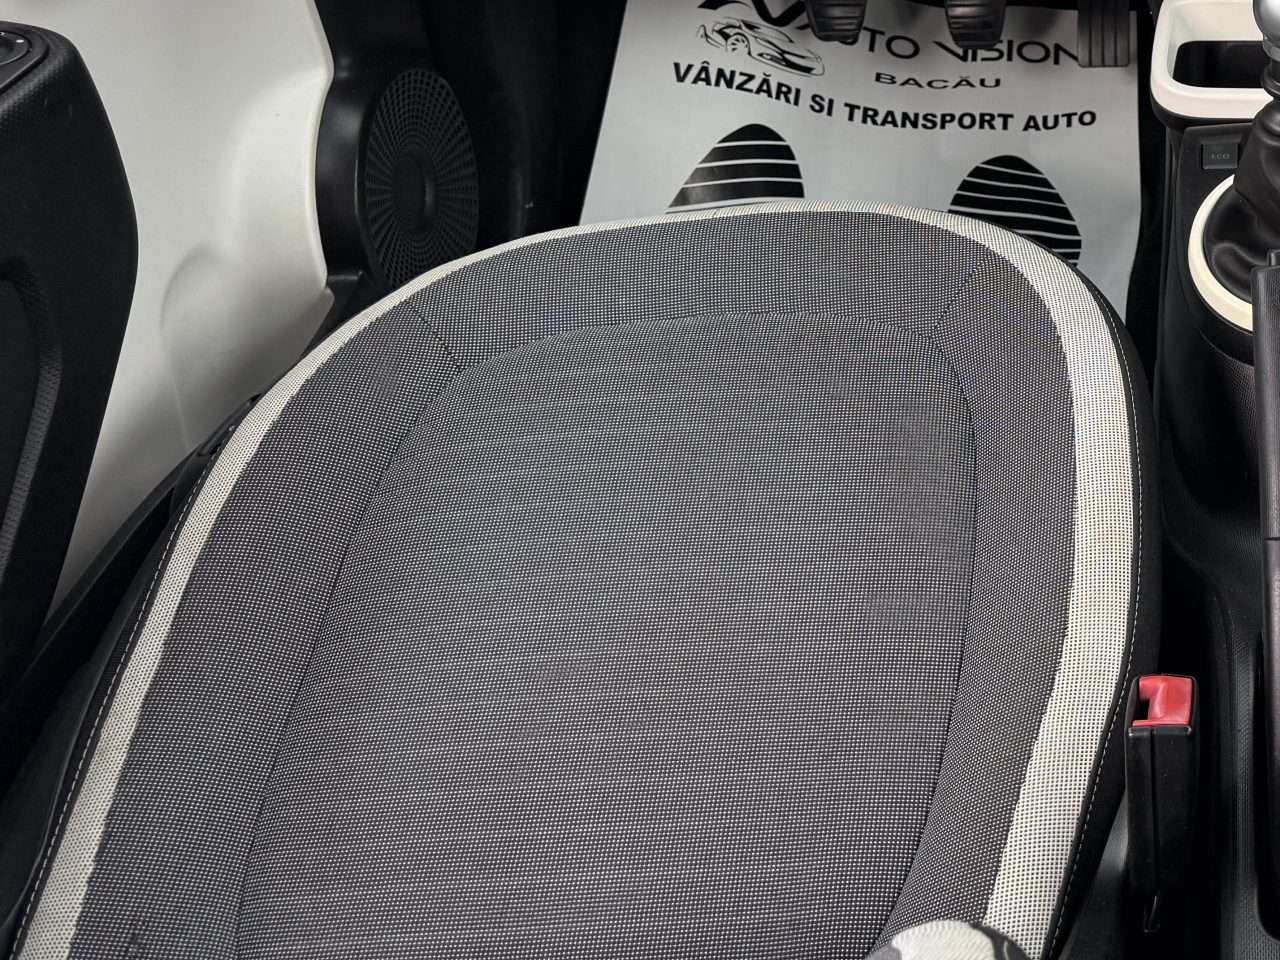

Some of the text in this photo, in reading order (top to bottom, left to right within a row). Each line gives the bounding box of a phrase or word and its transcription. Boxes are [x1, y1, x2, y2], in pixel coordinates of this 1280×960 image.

[673, 60, 1097, 132] VÂNZĂRI SI TRANSPORT AUTO
[873, 71, 1001, 89] BACĂU
